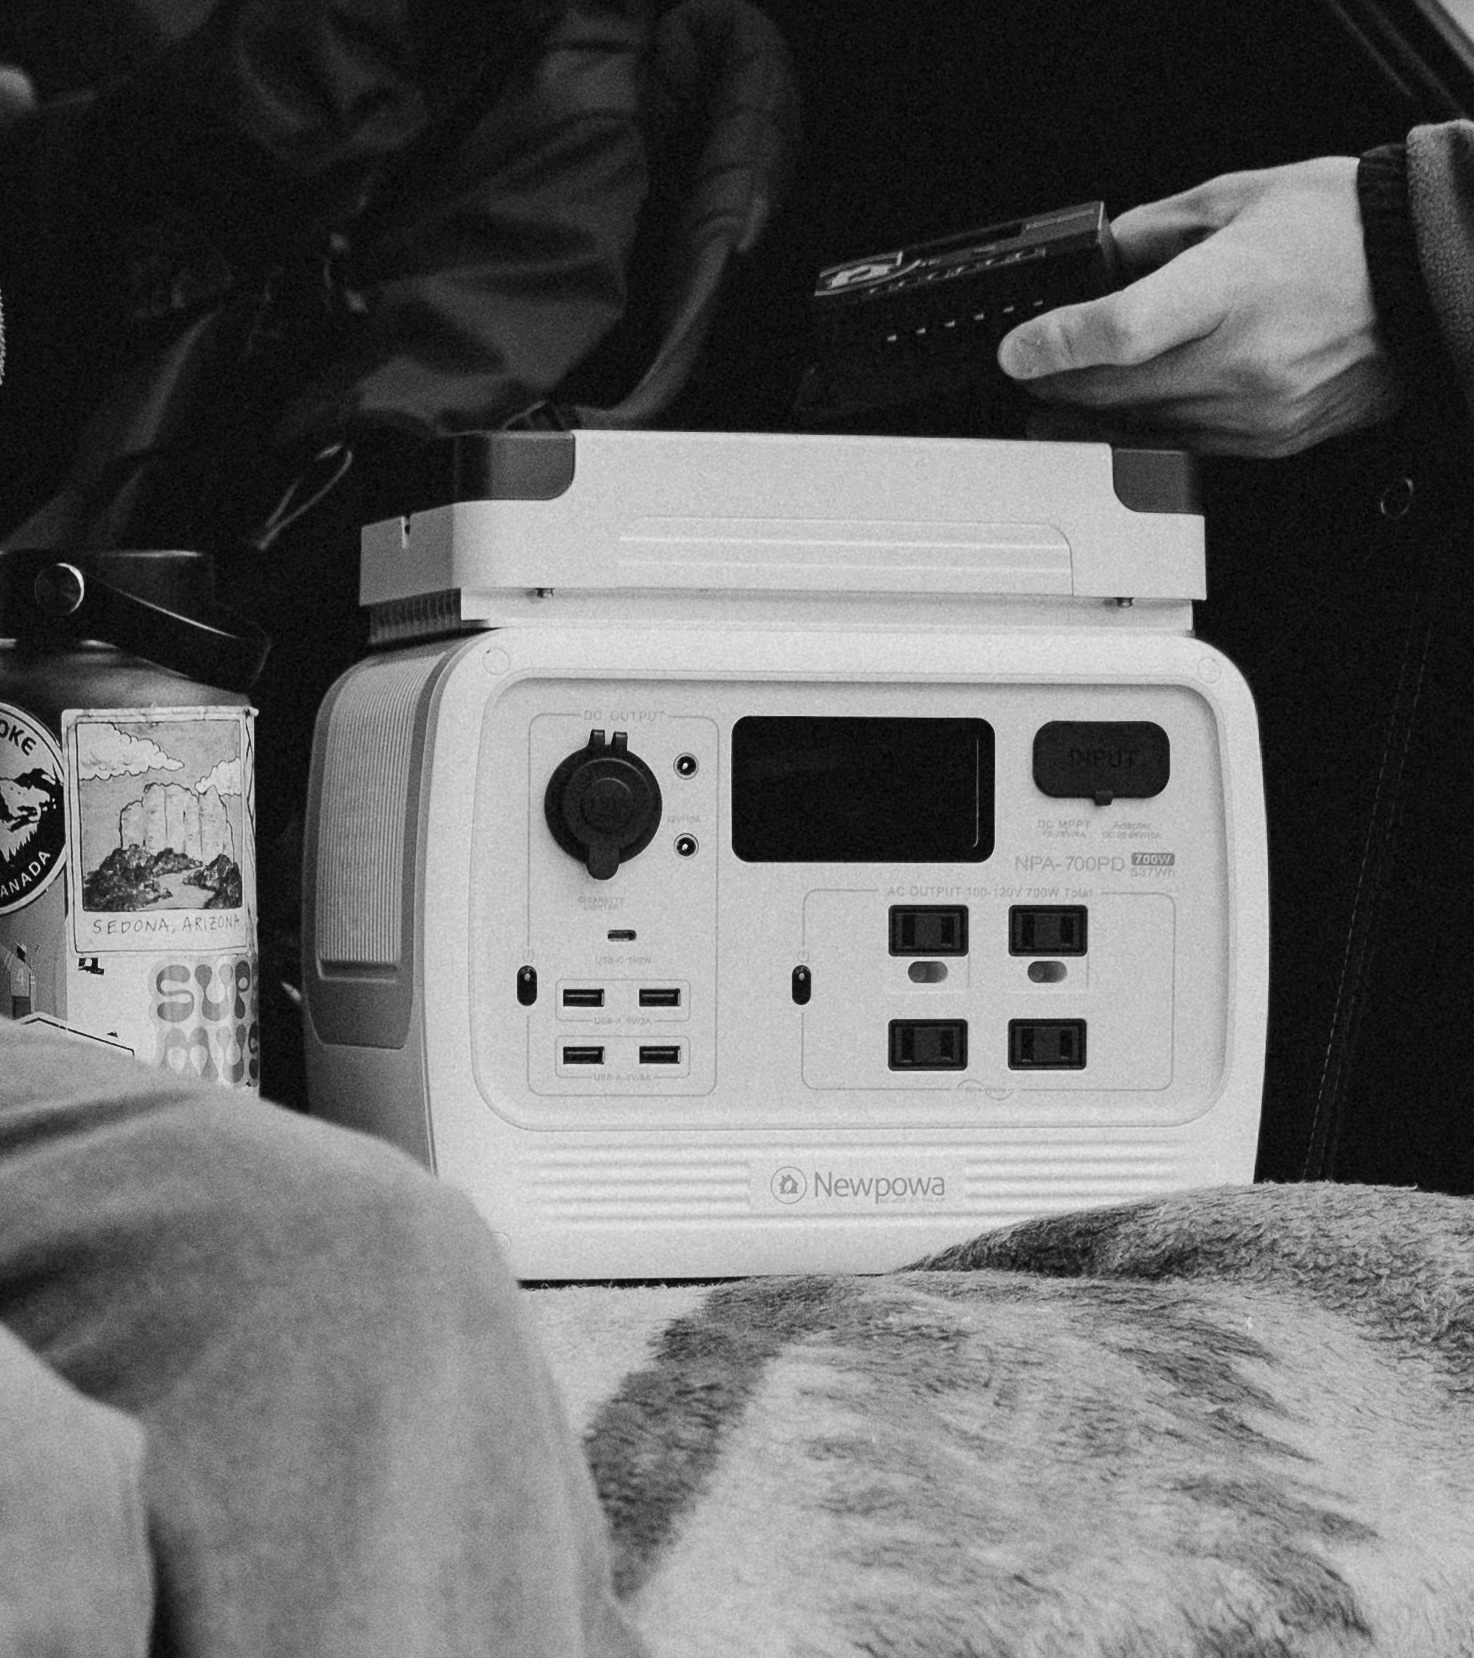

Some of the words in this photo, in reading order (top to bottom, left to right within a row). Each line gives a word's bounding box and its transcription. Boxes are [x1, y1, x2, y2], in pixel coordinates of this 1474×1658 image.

[610, 709, 665, 722] OUTPUT
[1014, 855, 1126, 873] NPA-700PD
[1134, 853, 1172, 865] 700W
[886, 885, 905, 897] AC
[909, 885, 961, 898] OUTPUT
[92, 918, 177, 935] SEDONA,
[181, 914, 241, 934] ARIZONA
[814, 1171, 945, 1205] Newpowa
